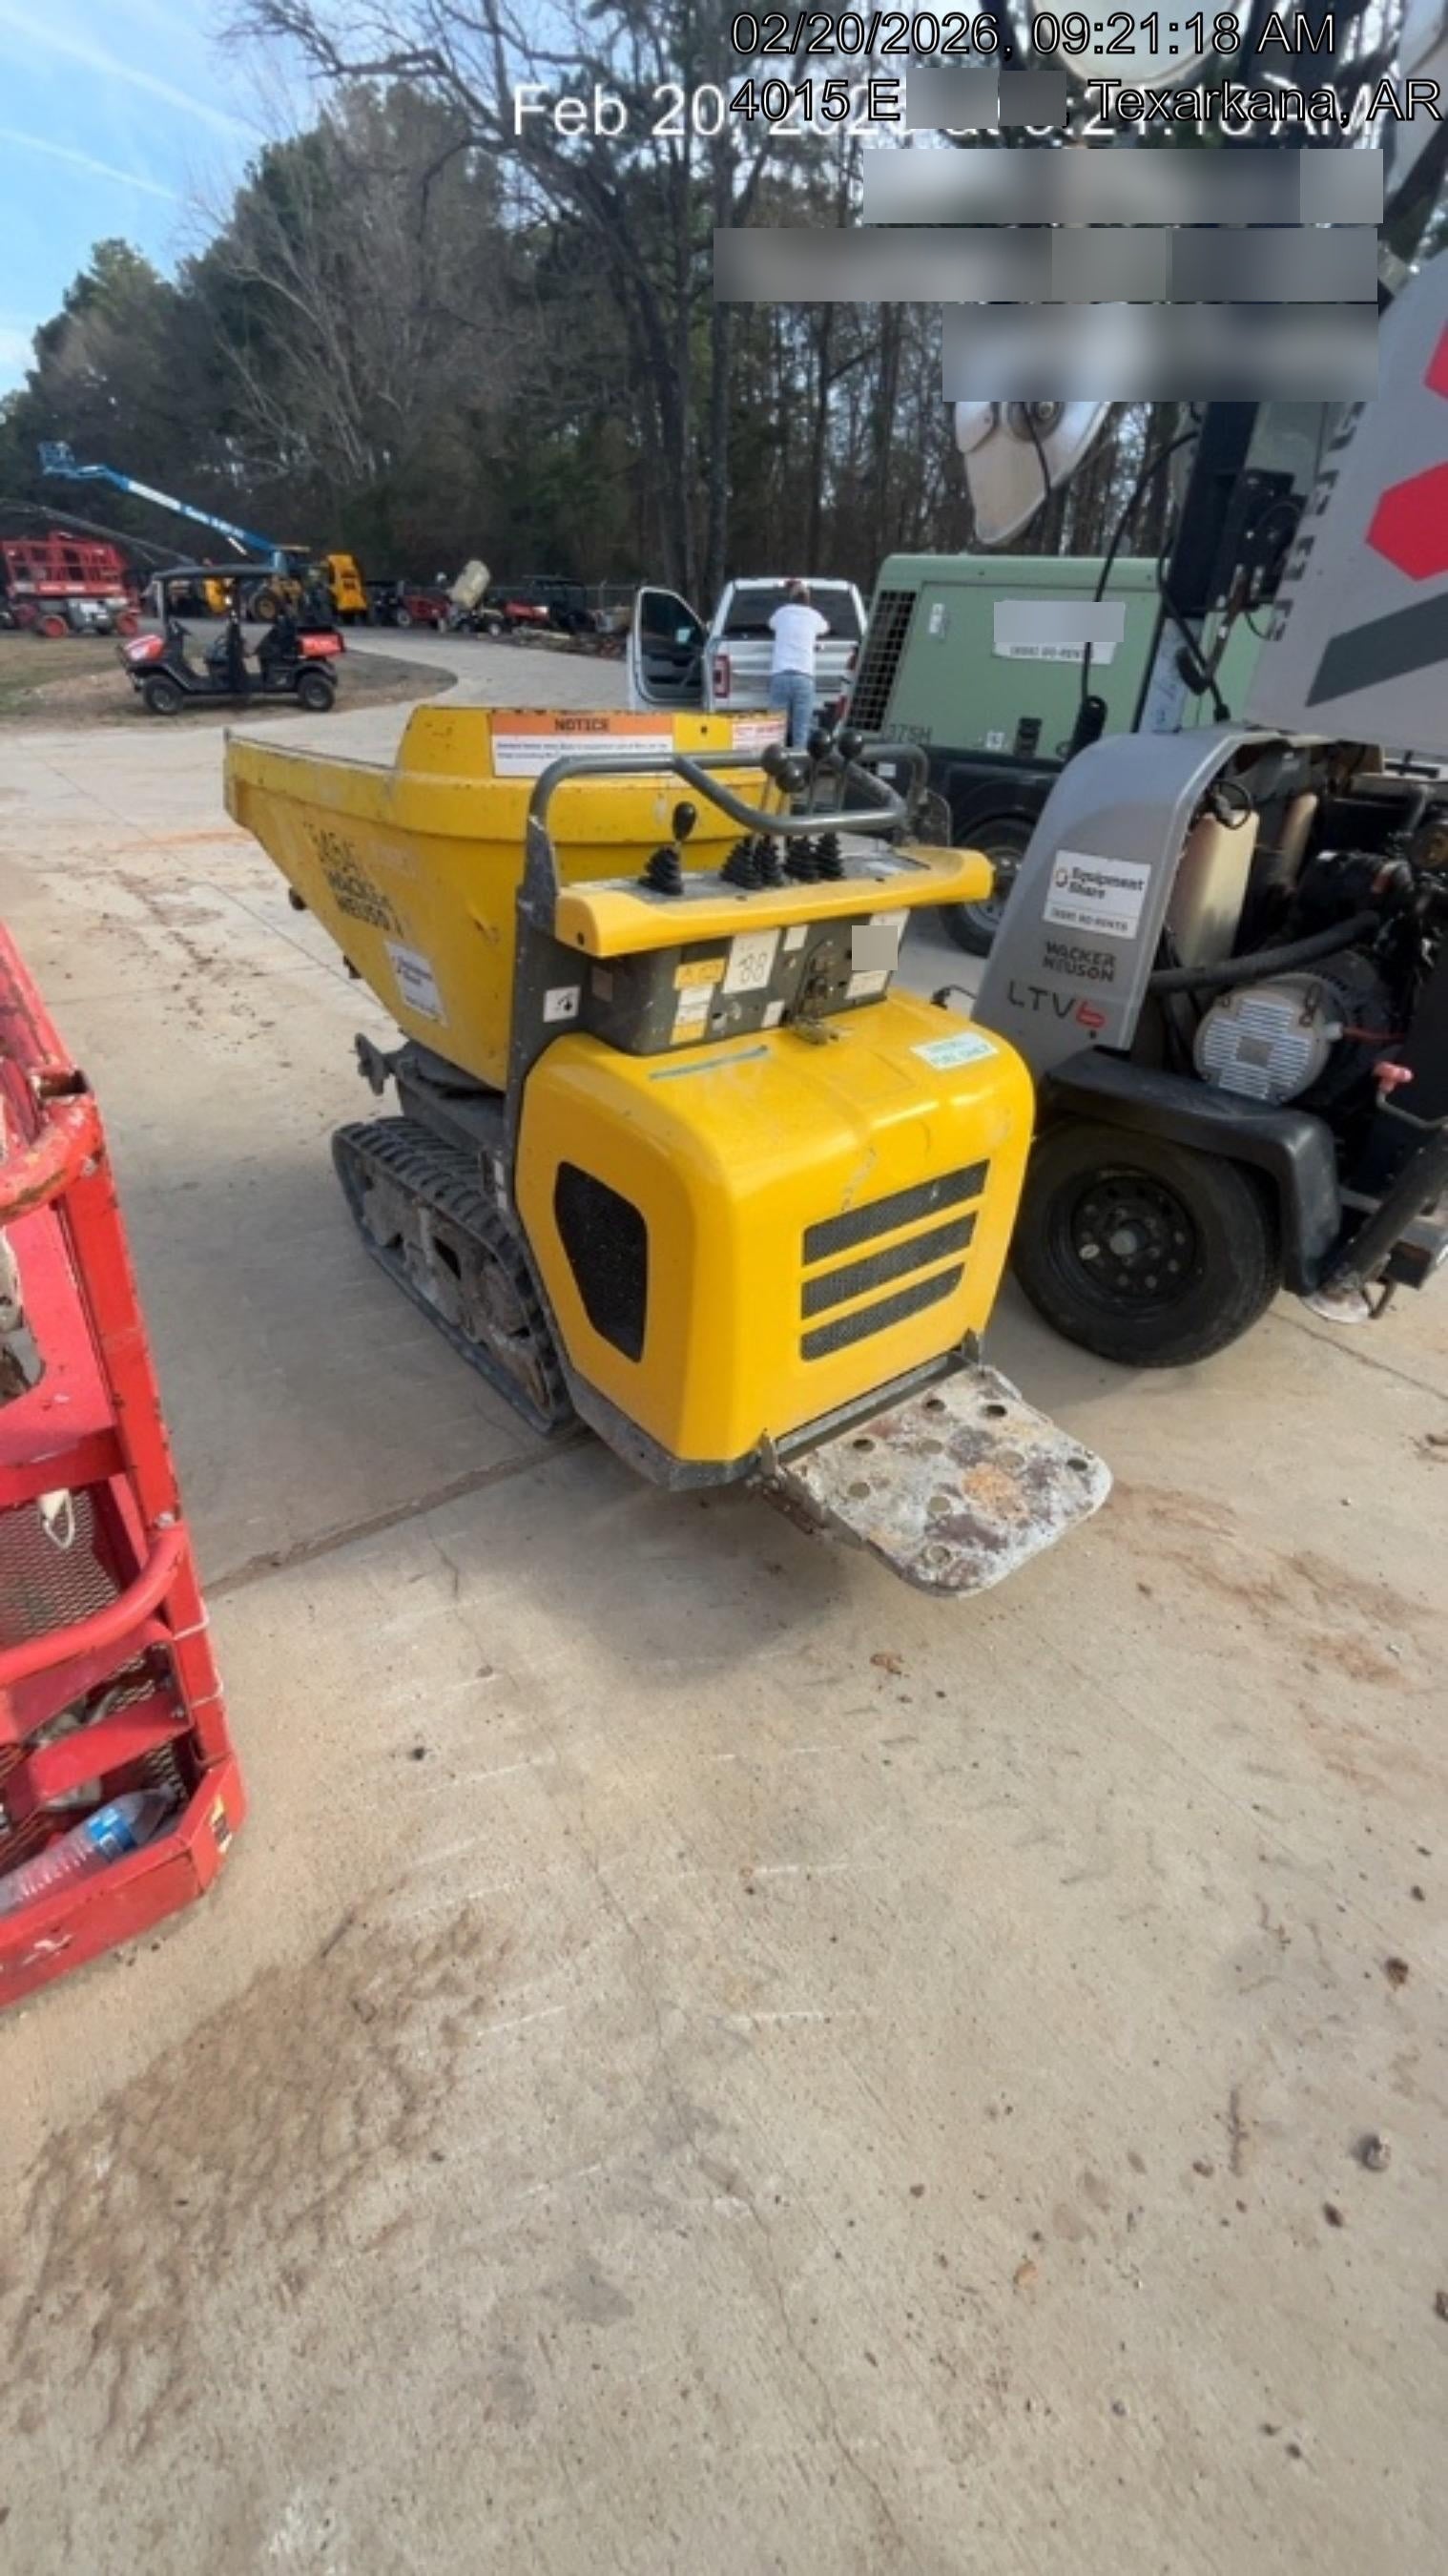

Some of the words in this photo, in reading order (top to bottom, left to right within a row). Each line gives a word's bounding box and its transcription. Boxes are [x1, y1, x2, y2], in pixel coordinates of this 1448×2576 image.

[554, 717, 610, 732] NOTICE
[1068, 882, 1107, 899] Share
[1071, 866, 1145, 893] Equipment
[1045, 941, 1117, 967] WACKER
[1042, 956, 1114, 983] NEUSON
[1007, 980, 1107, 1028] LTV6
